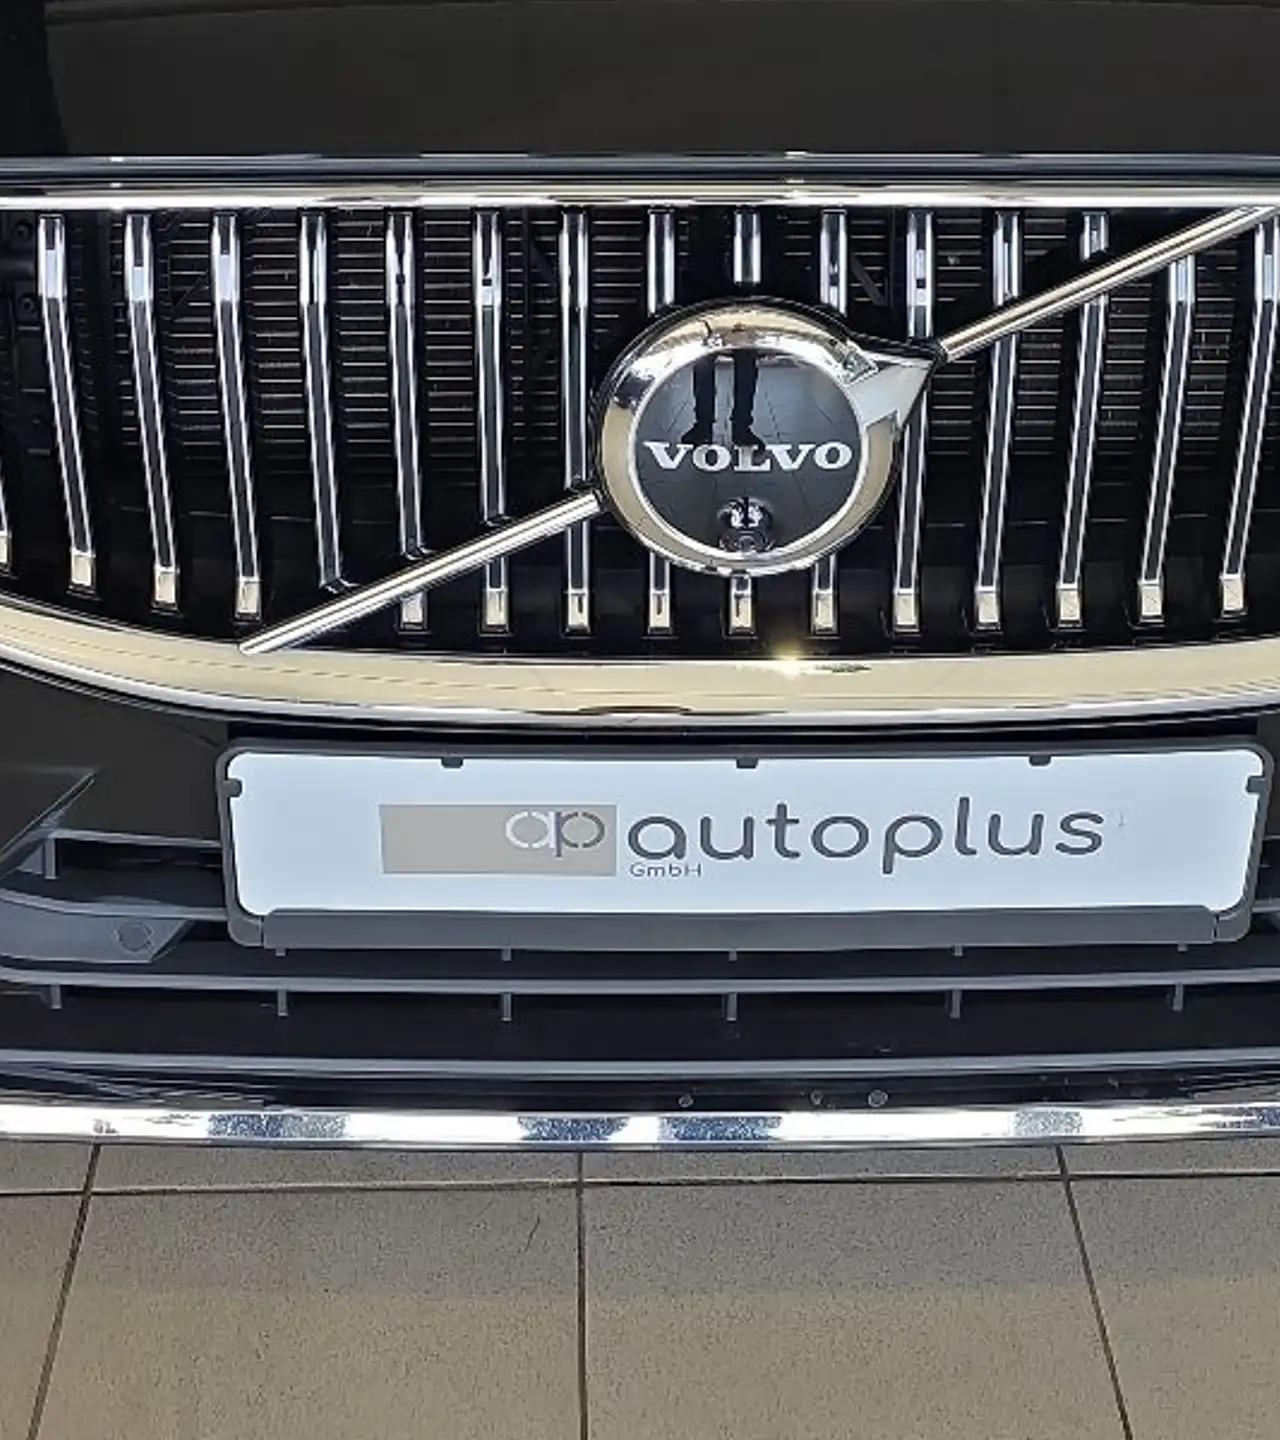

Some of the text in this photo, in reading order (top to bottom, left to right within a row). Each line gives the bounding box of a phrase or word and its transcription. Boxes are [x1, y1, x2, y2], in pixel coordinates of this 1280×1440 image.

[642, 441, 853, 472] VOLVO
[627, 796, 1105, 876] autoplus
[629, 862, 702, 878] GmbH
